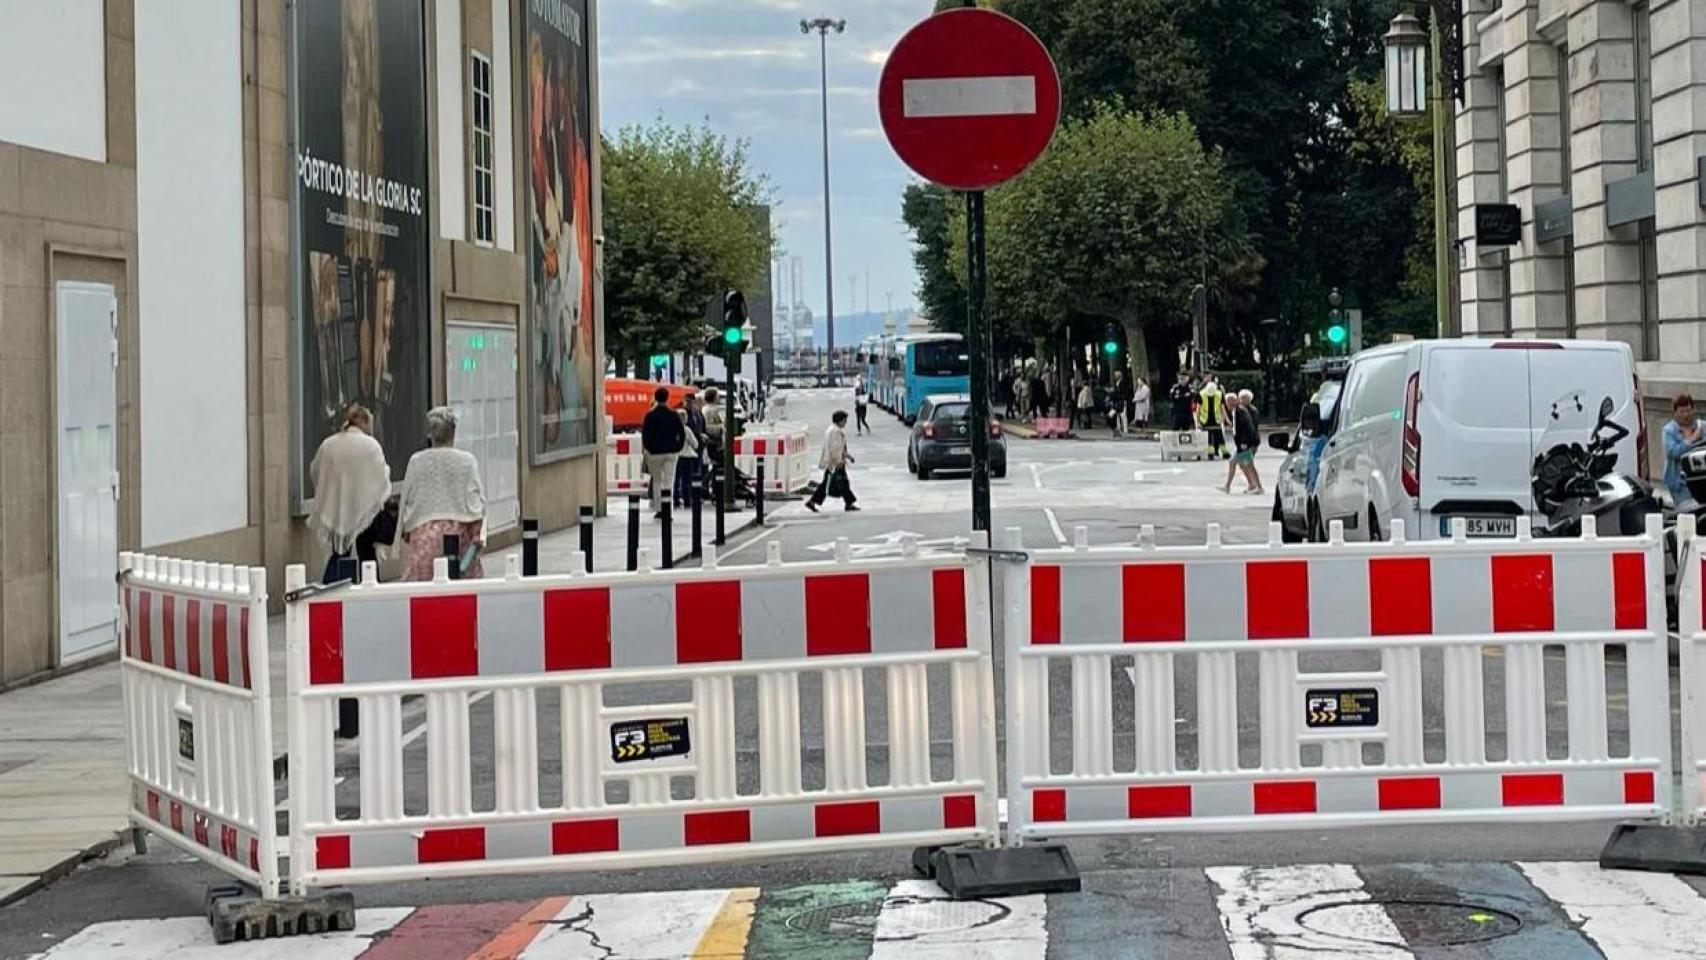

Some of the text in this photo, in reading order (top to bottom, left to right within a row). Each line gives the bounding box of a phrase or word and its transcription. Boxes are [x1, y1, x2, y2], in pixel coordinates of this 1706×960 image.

[298, 147, 422, 217] PÓRTICO DE LA GLORIA SC
[1486, 519, 1511, 533] MVH
[1308, 697, 1338, 712] F3
[614, 729, 645, 747] F3
